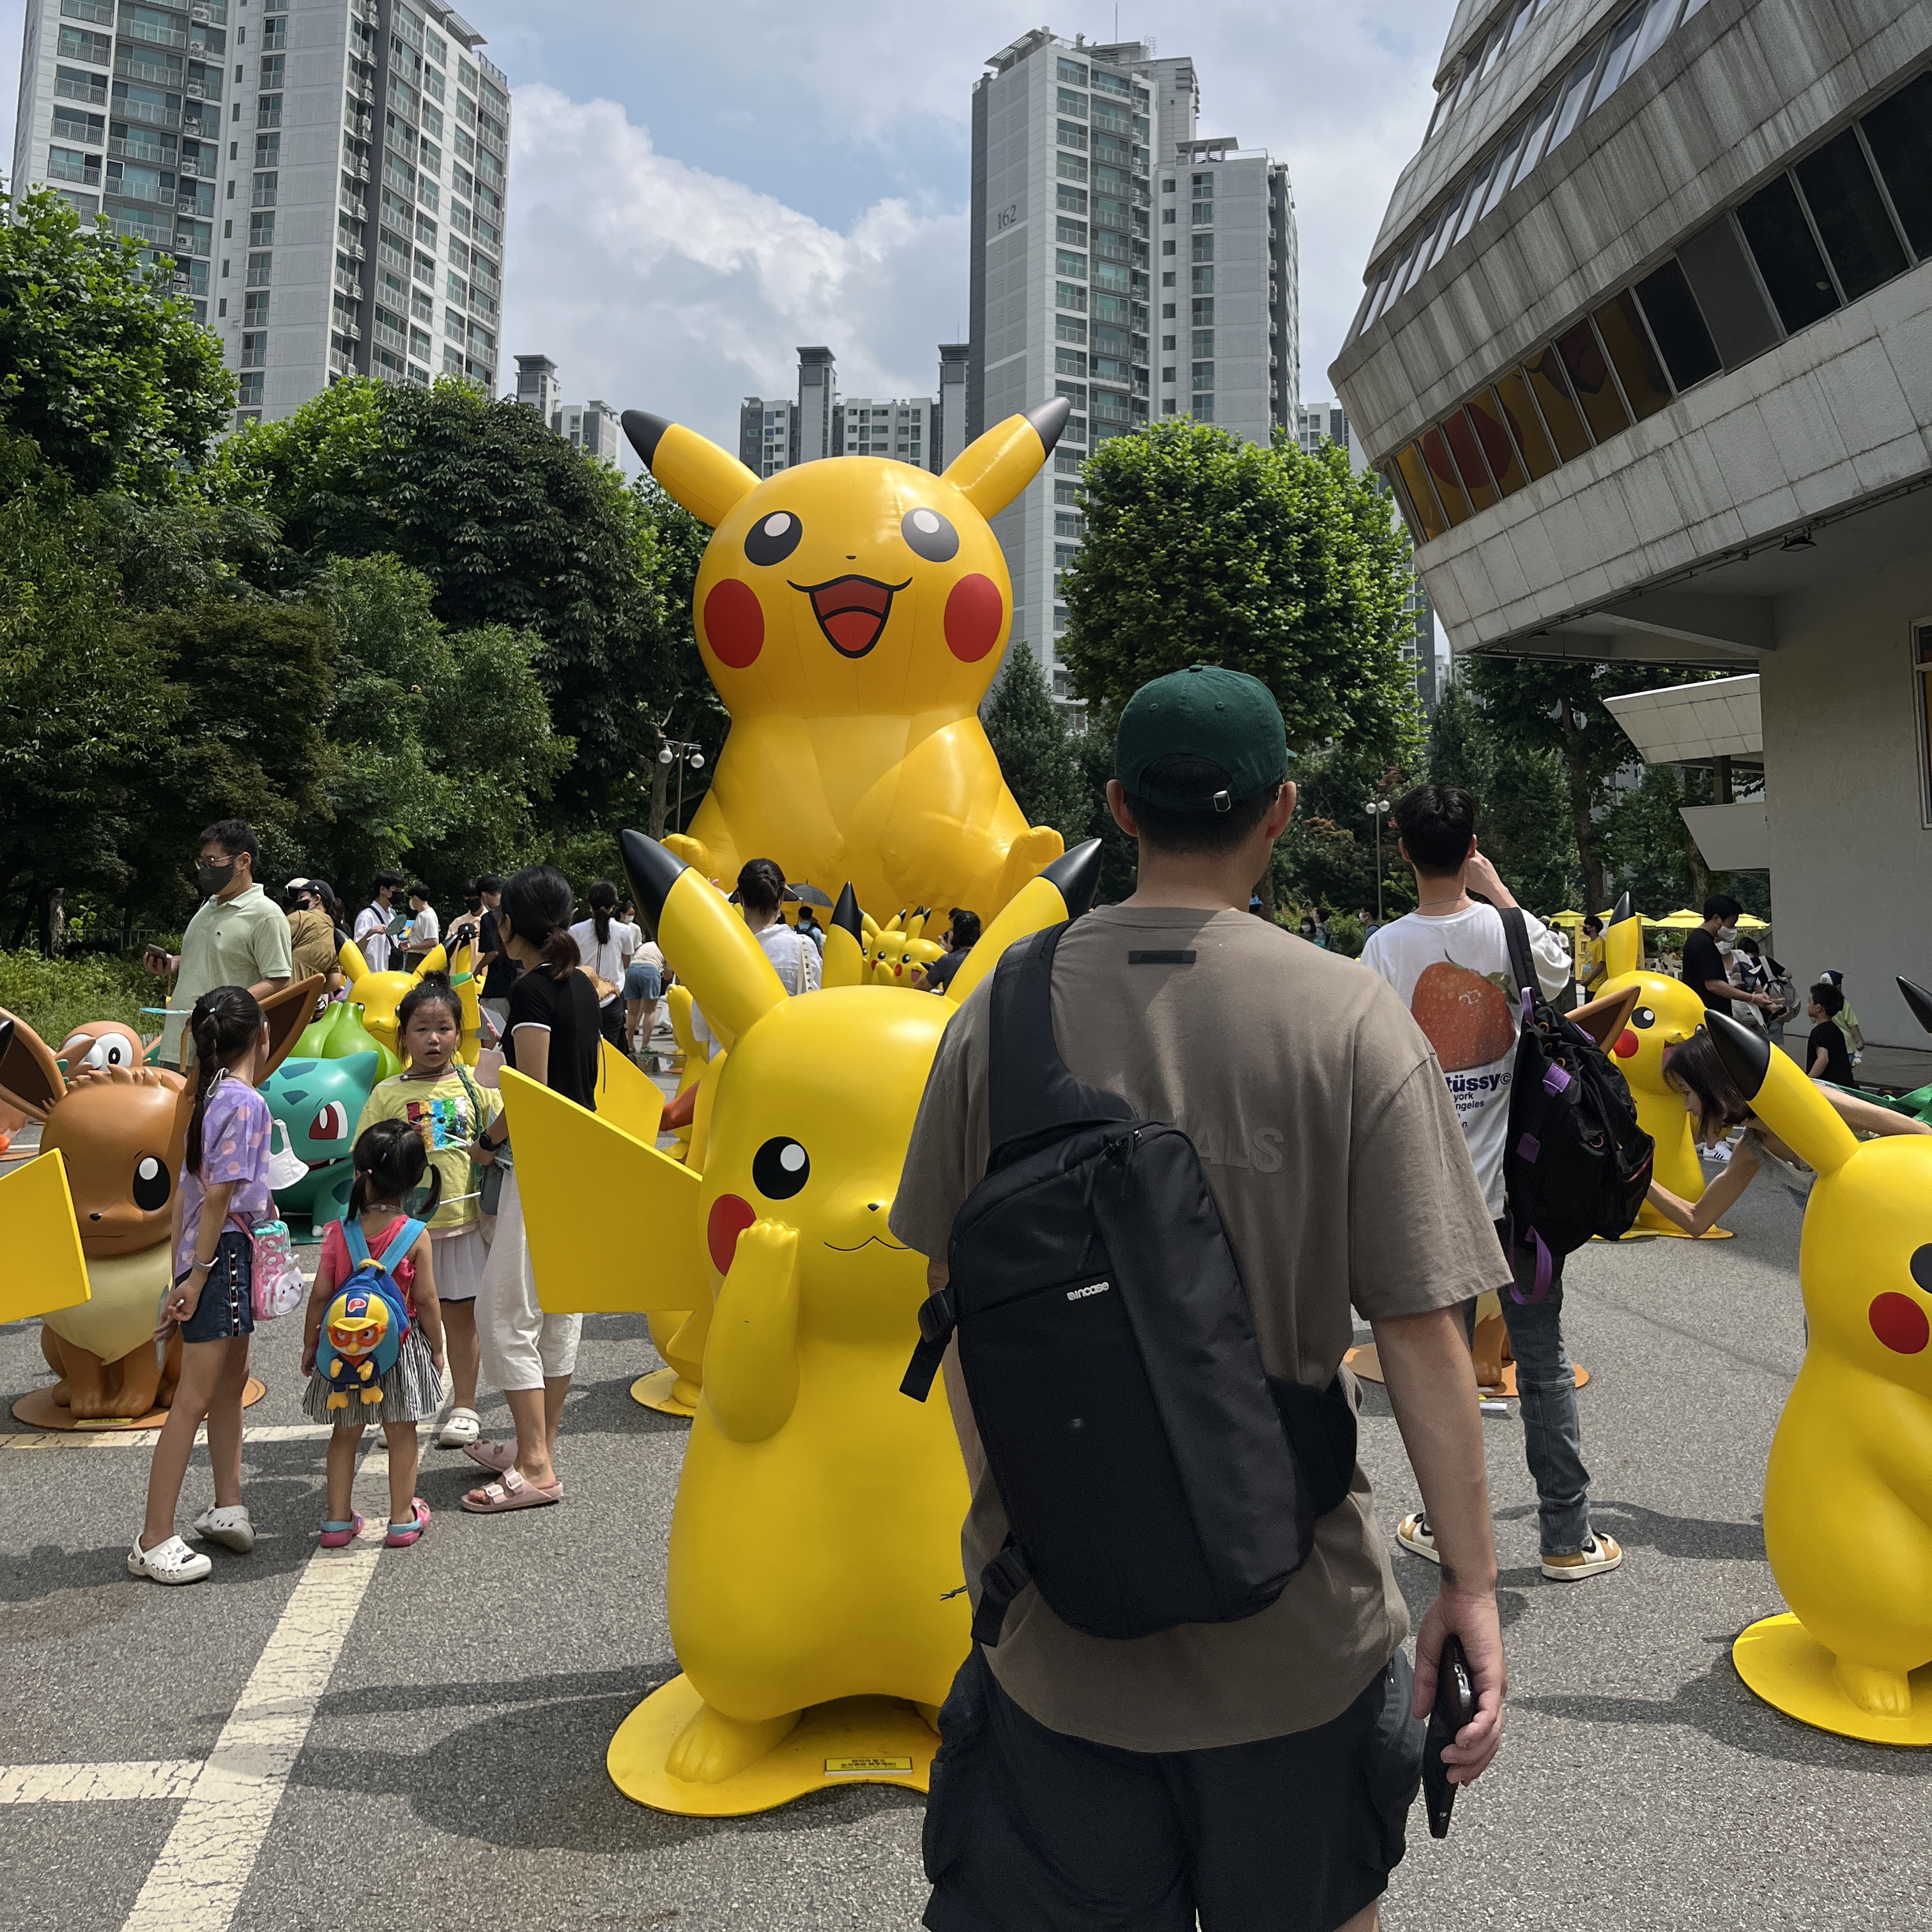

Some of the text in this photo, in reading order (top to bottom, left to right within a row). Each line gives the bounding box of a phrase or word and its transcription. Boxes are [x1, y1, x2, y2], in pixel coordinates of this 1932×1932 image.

[997, 204, 1016, 230] 162
[1454, 1092, 1474, 1103] york
[1456, 1100, 1484, 1112] ngeles
[348, 1298, 367, 1312] P
